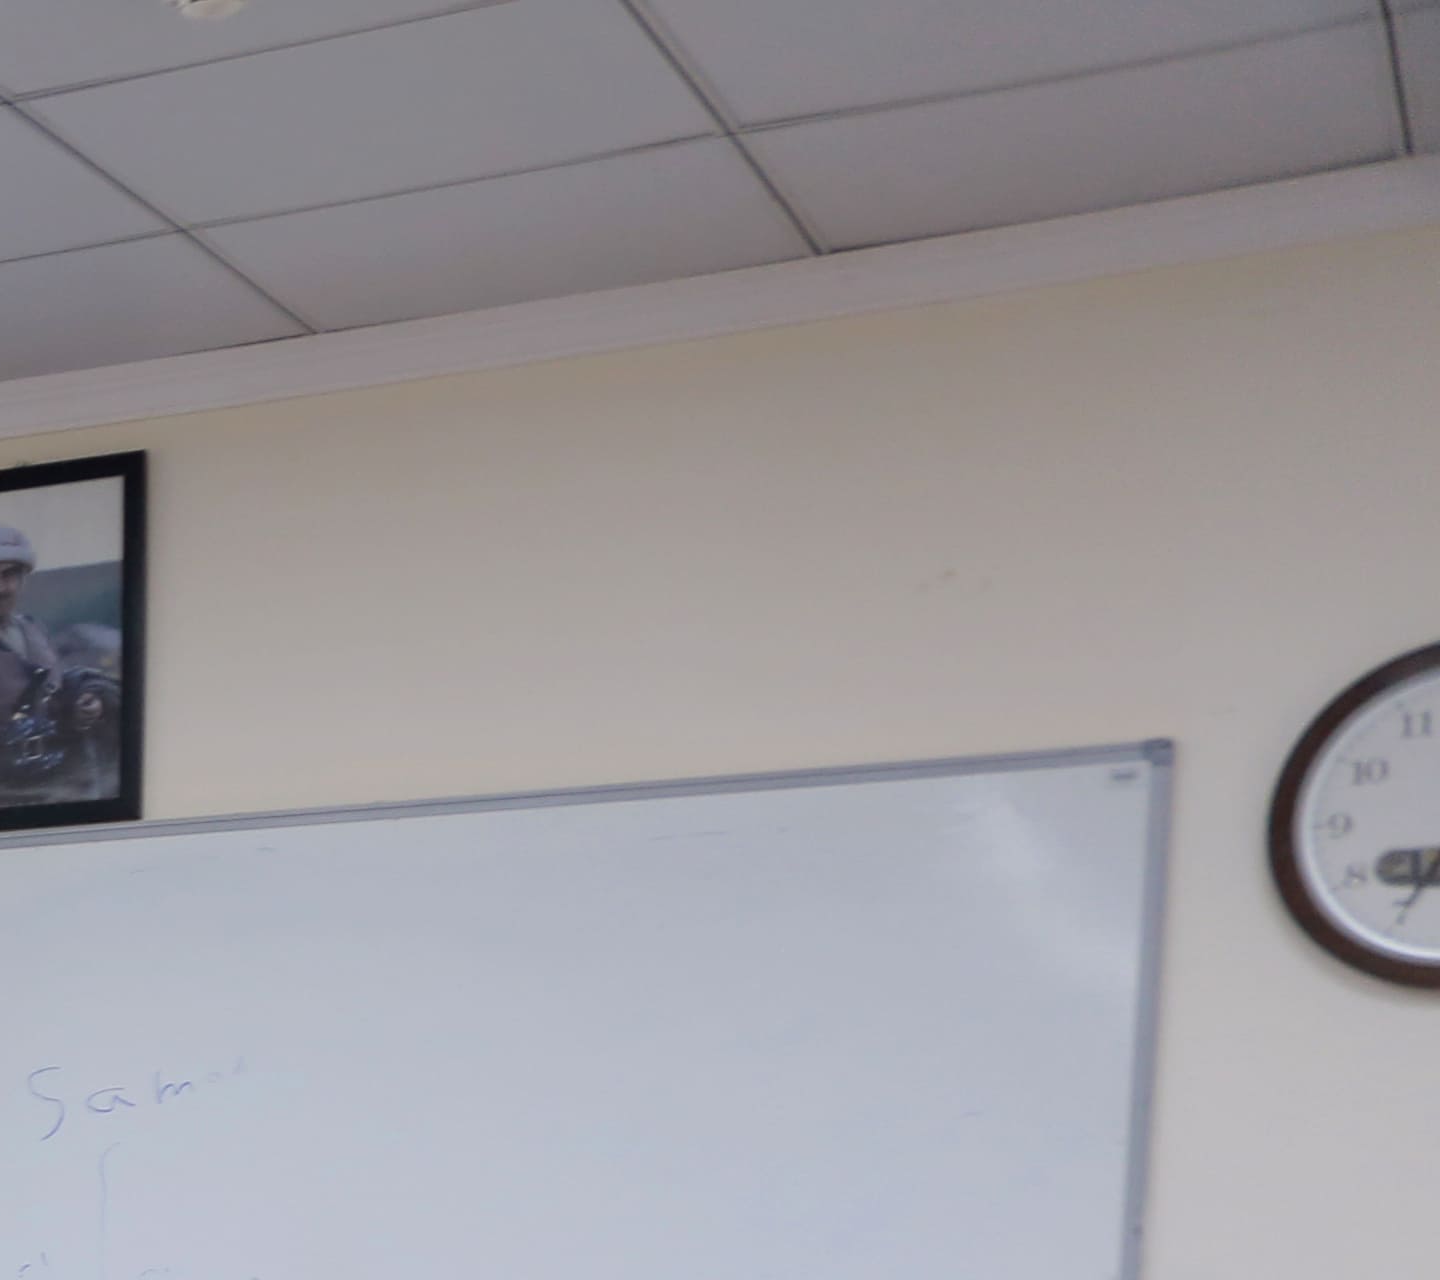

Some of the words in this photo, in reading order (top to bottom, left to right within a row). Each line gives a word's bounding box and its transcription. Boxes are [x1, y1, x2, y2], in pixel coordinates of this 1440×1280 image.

[1400, 711, 1433, 738] 11
[1351, 758, 1390, 787] 10
[1328, 813, 1353, 839] 9
